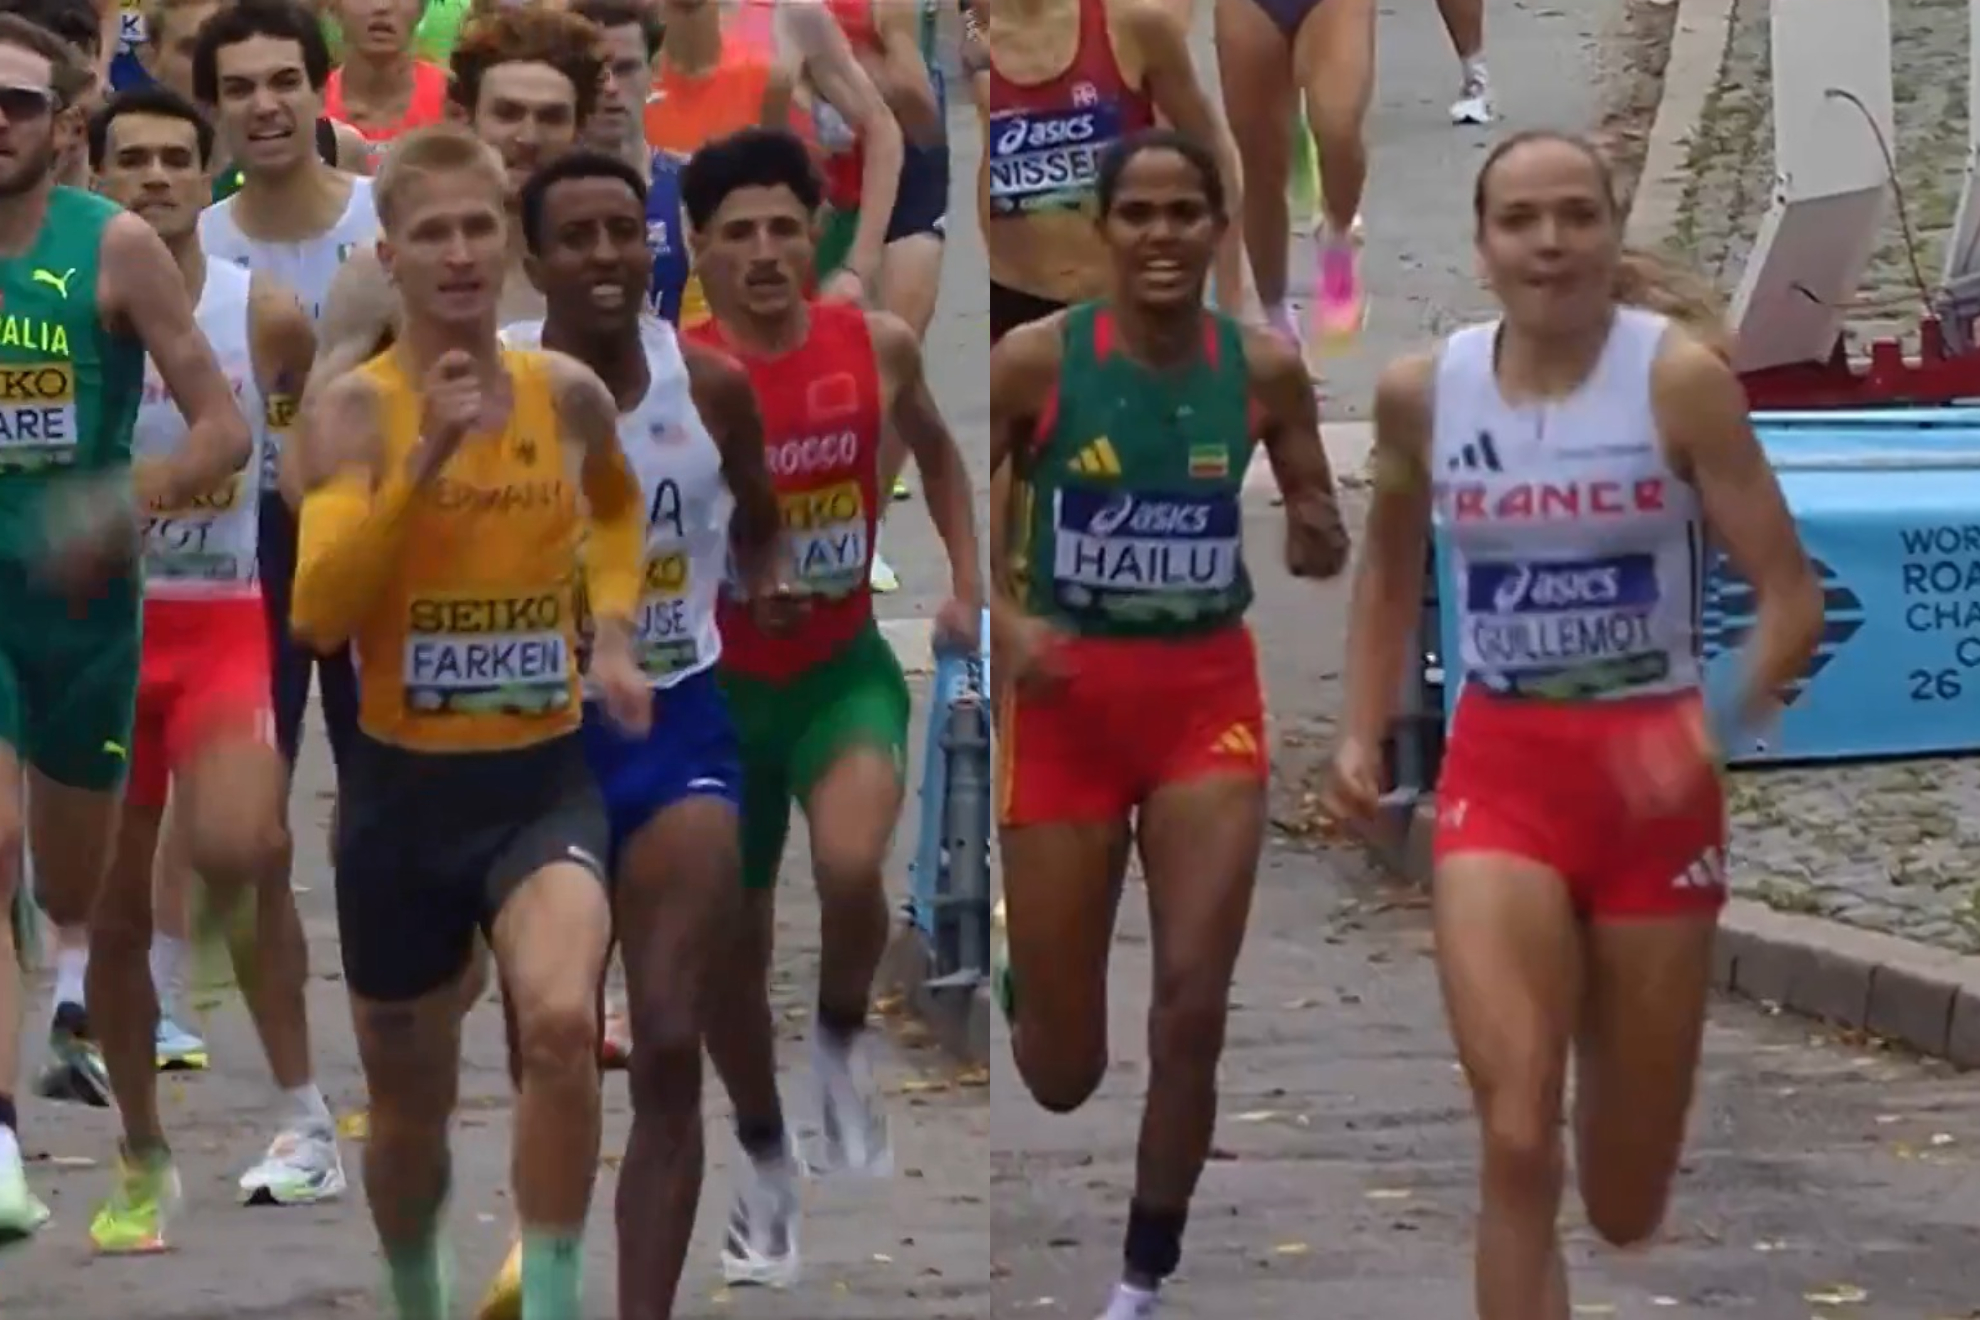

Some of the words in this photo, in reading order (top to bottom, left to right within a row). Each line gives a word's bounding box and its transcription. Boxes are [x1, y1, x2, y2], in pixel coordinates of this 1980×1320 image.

[1028, 114, 1094, 147] asics
[990, 150, 1099, 188] NISSE
[0, 314, 69, 356] ALIA
[0, 367, 68, 398] KO
[1075, 540, 1218, 584] HAILU
[411, 594, 560, 633] SEIKO
[412, 638, 561, 682] FARKEN
[1909, 668, 1962, 700] 26
